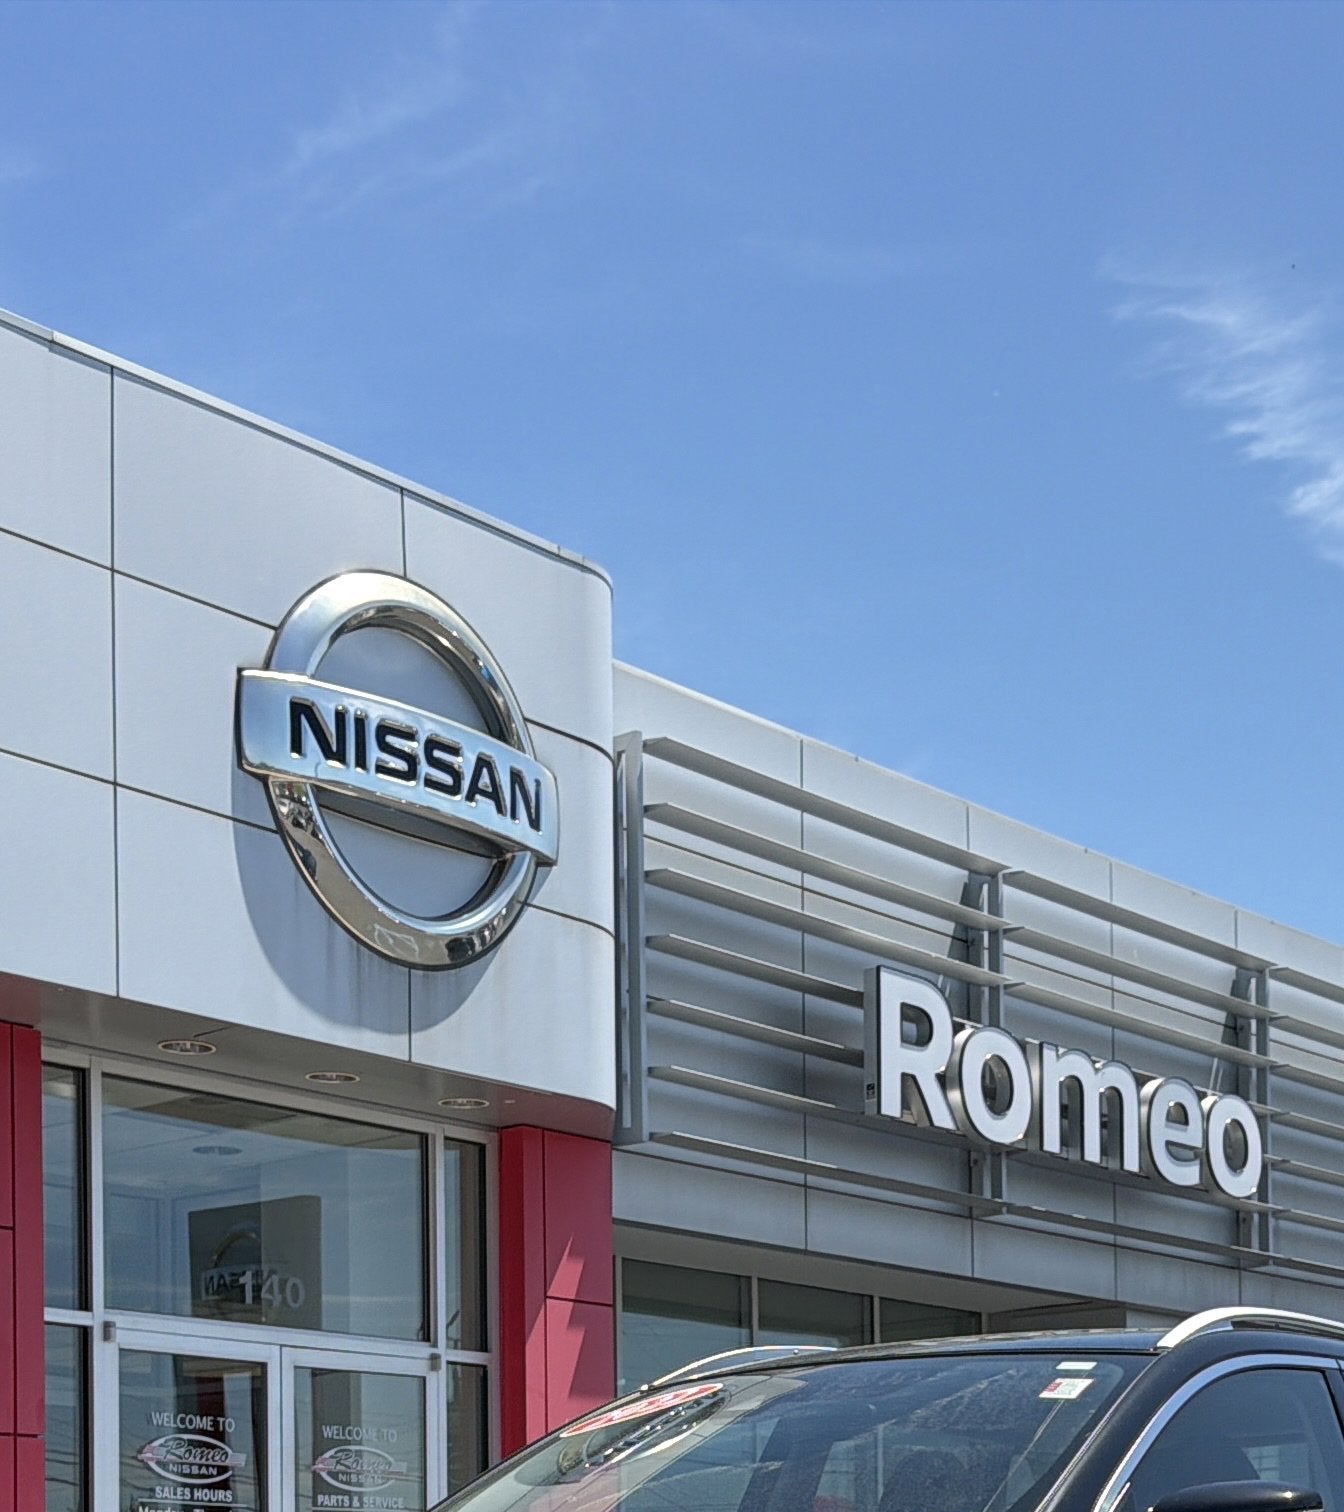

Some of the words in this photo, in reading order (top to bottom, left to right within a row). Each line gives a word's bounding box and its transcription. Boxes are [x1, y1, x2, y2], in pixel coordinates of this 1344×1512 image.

[289, 696, 542, 834] NISSAN
[866, 964, 1263, 1198] Romeo
[238, 1269, 306, 1309] 140
[151, 1411, 214, 1431] WELCOME
[216, 1416, 235, 1432] TO
[322, 1425, 380, 1441] WELCOME
[382, 1429, 397, 1442] TO
[158, 1437, 229, 1463] Romeo
[332, 1449, 393, 1472] Romeo
[169, 1463, 217, 1475] NISSAN
[338, 1473, 383, 1483] NISSAN
[156, 1486, 191, 1500] SALES
[194, 1488, 233, 1502] HOURS
[317, 1494, 350, 1507] PARTS
[353, 1496, 360, 1508] &
[362, 1496, 405, 1508] SERVICE
